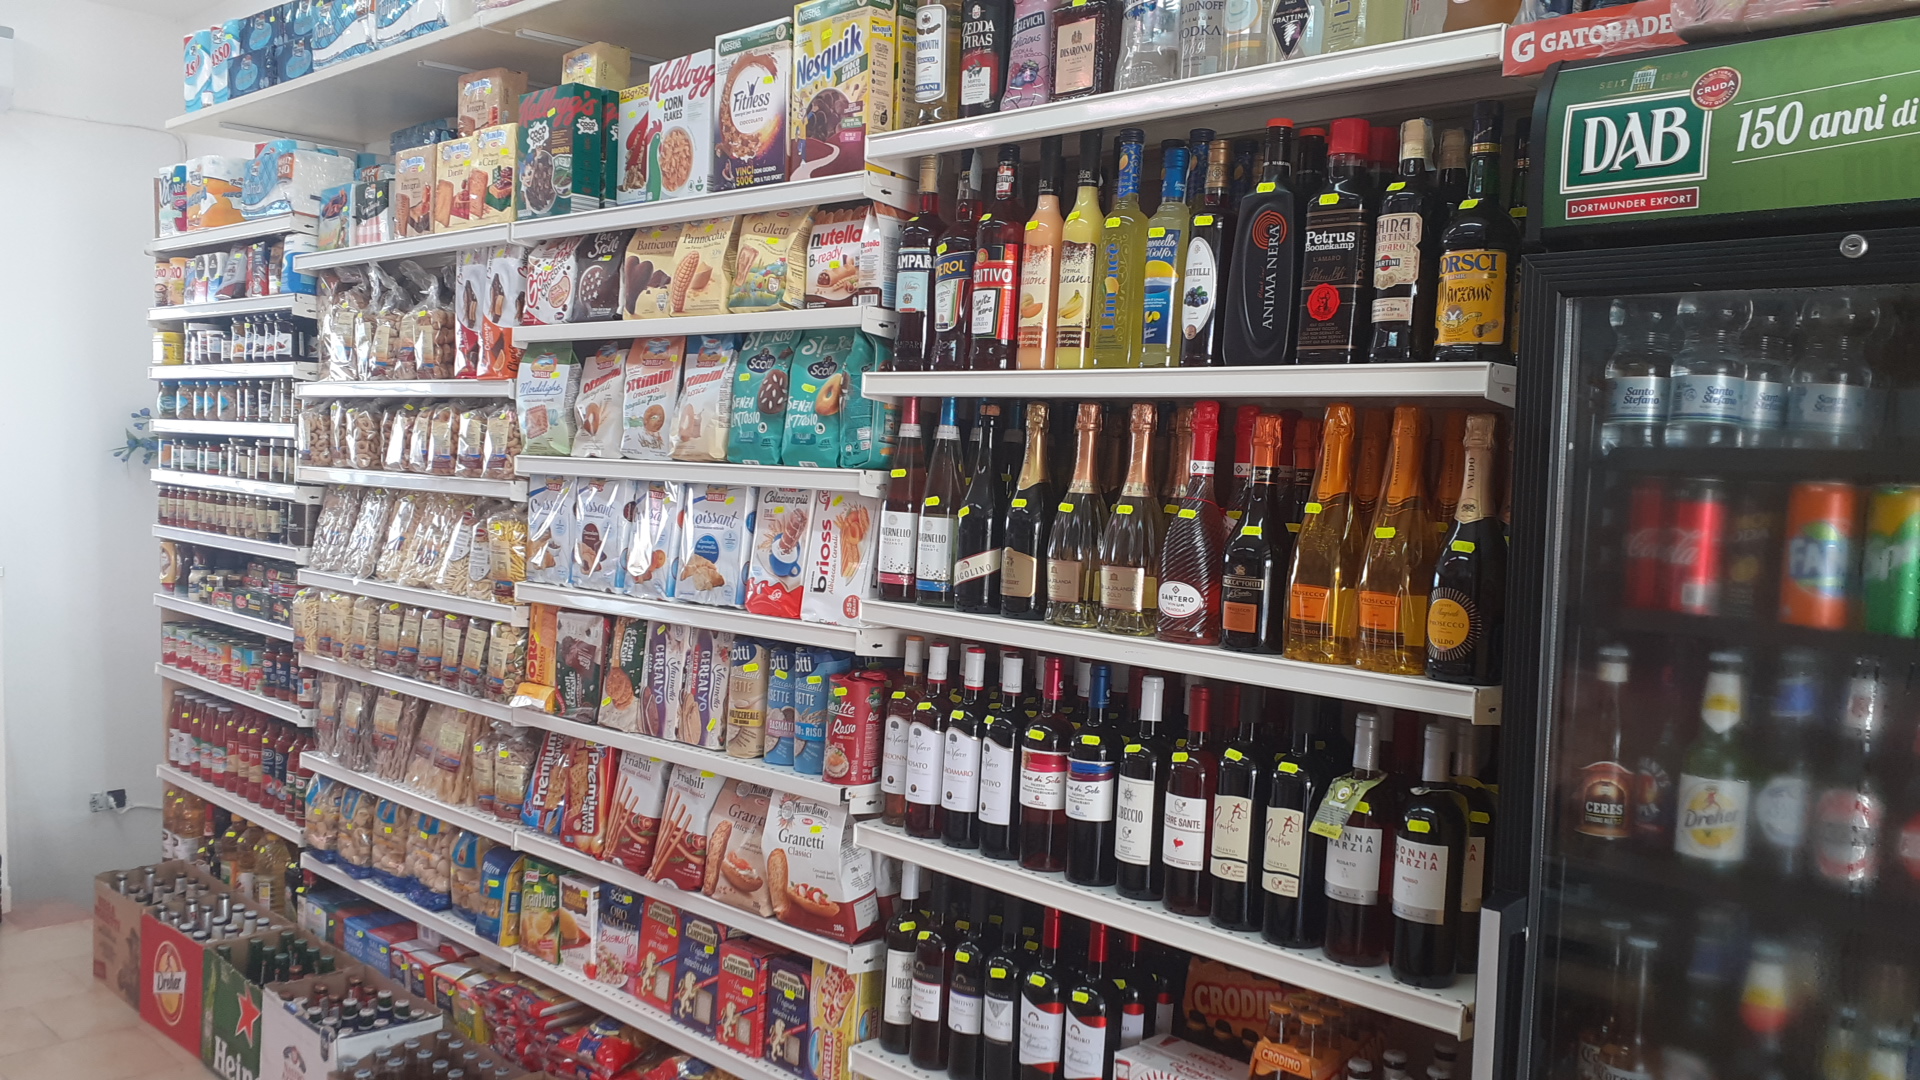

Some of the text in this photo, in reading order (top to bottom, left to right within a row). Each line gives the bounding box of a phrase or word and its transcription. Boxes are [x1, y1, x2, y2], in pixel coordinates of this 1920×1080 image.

[1272, 13, 1309, 24] FRATTINA
[872, 24, 892, 33] Nesquik
[962, 20, 995, 36] ZEDDA
[1540, 15, 1673, 53] GATORADE
[917, 39, 940, 52] ERMOUTH
[962, 34, 993, 50] PIRAS
[796, 24, 862, 89] Nesquik
[1060, 43, 1092, 58] DISARONNO
[842, 58, 860, 73] CHOCO
[842, 66, 860, 82] WAVES
[1697, 80, 1736, 96] CRUDA
[663, 95, 683, 111] CORN
[733, 90, 771, 112] Fitness
[663, 109, 683, 122] FLAKES
[739, 117, 764, 126] CIOCCOLATO
[1736, 92, 1920, 152] 150 anni di
[1580, 106, 1690, 174] DAB
[736, 165, 754, 176] VINCI
[736, 174, 754, 187] 500€
[1571, 193, 1692, 214] DORTMUNDER EXPORT
[753, 221, 791, 236] Galletti
[811, 224, 863, 247] nutella
[637, 239, 678, 251] Batticuori
[861, 241, 880, 249] nutella
[1305, 231, 1356, 246] Petrus
[1305, 242, 1355, 252] Boonekamp
[809, 246, 843, 268] B-ready
[897, 254, 935, 269] AMPARI
[1313, 255, 1341, 263] L'AMARO
[1375, 258, 1400, 268] MARTINI
[1440, 253, 1497, 275] ORSCI
[935, 260, 966, 278] PEROL
[1262, 224, 1280, 330] ANIMA NERA
[749, 359, 773, 370] Scotti
[810, 364, 835, 376] Scotti
[1626, 386, 1655, 396] Santo
[1705, 385, 1735, 397] Santo
[732, 396, 755, 409] SENZA
[1623, 395, 1660, 406] Stefano
[1702, 394, 1737, 406] Stefano
[1466, 456, 1476, 490] VALDO
[764, 490, 808, 507] Colazione più
[814, 519, 831, 593] brioss
[1162, 593, 1195, 604] SANTERO
[1291, 589, 1326, 598] PROSECCO
[1361, 596, 1396, 606] PROSECCO
[1430, 620, 1465, 629] PROSECCO
[1434, 637, 1455, 646] VALDO
[527, 634, 540, 679] ORO
[731, 646, 750, 661] otti
[536, 645, 545, 683] Classico
[770, 654, 788, 670] otti
[796, 656, 812, 672] otti
[654, 644, 665, 704] CEREALYO
[698, 650, 711, 712] CEREALYO
[769, 719, 794, 732] BASMATI
[805, 725, 822, 738] RISO
[832, 719, 856, 735] Rosso
[533, 731, 557, 806] Premiu
[624, 754, 651, 772] Friabili
[676, 769, 705, 790] Friabili
[587, 751, 600, 834] Premium
[794, 802, 829, 819] MULINO BIANCO
[1585, 801, 1623, 816] CERES
[1178, 815, 1201, 830] SANTE
[1684, 807, 1739, 828] Dreher
[778, 828, 825, 850] Granetti
[1328, 838, 1374, 854] MARZIA
[1342, 832, 1374, 845] NNA
[787, 846, 812, 859] Classici
[1396, 843, 1439, 862] DONNA
[1336, 858, 1357, 868] ROSATO
[1395, 854, 1438, 872] MARZIA
[1402, 876, 1419, 885] ROSSO
[610, 889, 632, 905] Scot
[610, 906, 628, 919] ORO
[601, 930, 631, 946] Basmati
[157, 973, 182, 991] Dreher
[891, 975, 911, 988] LIBEC
[823, 1033, 834, 1080] DIVELLA
[1261, 1049, 1301, 1073] CRODINO
